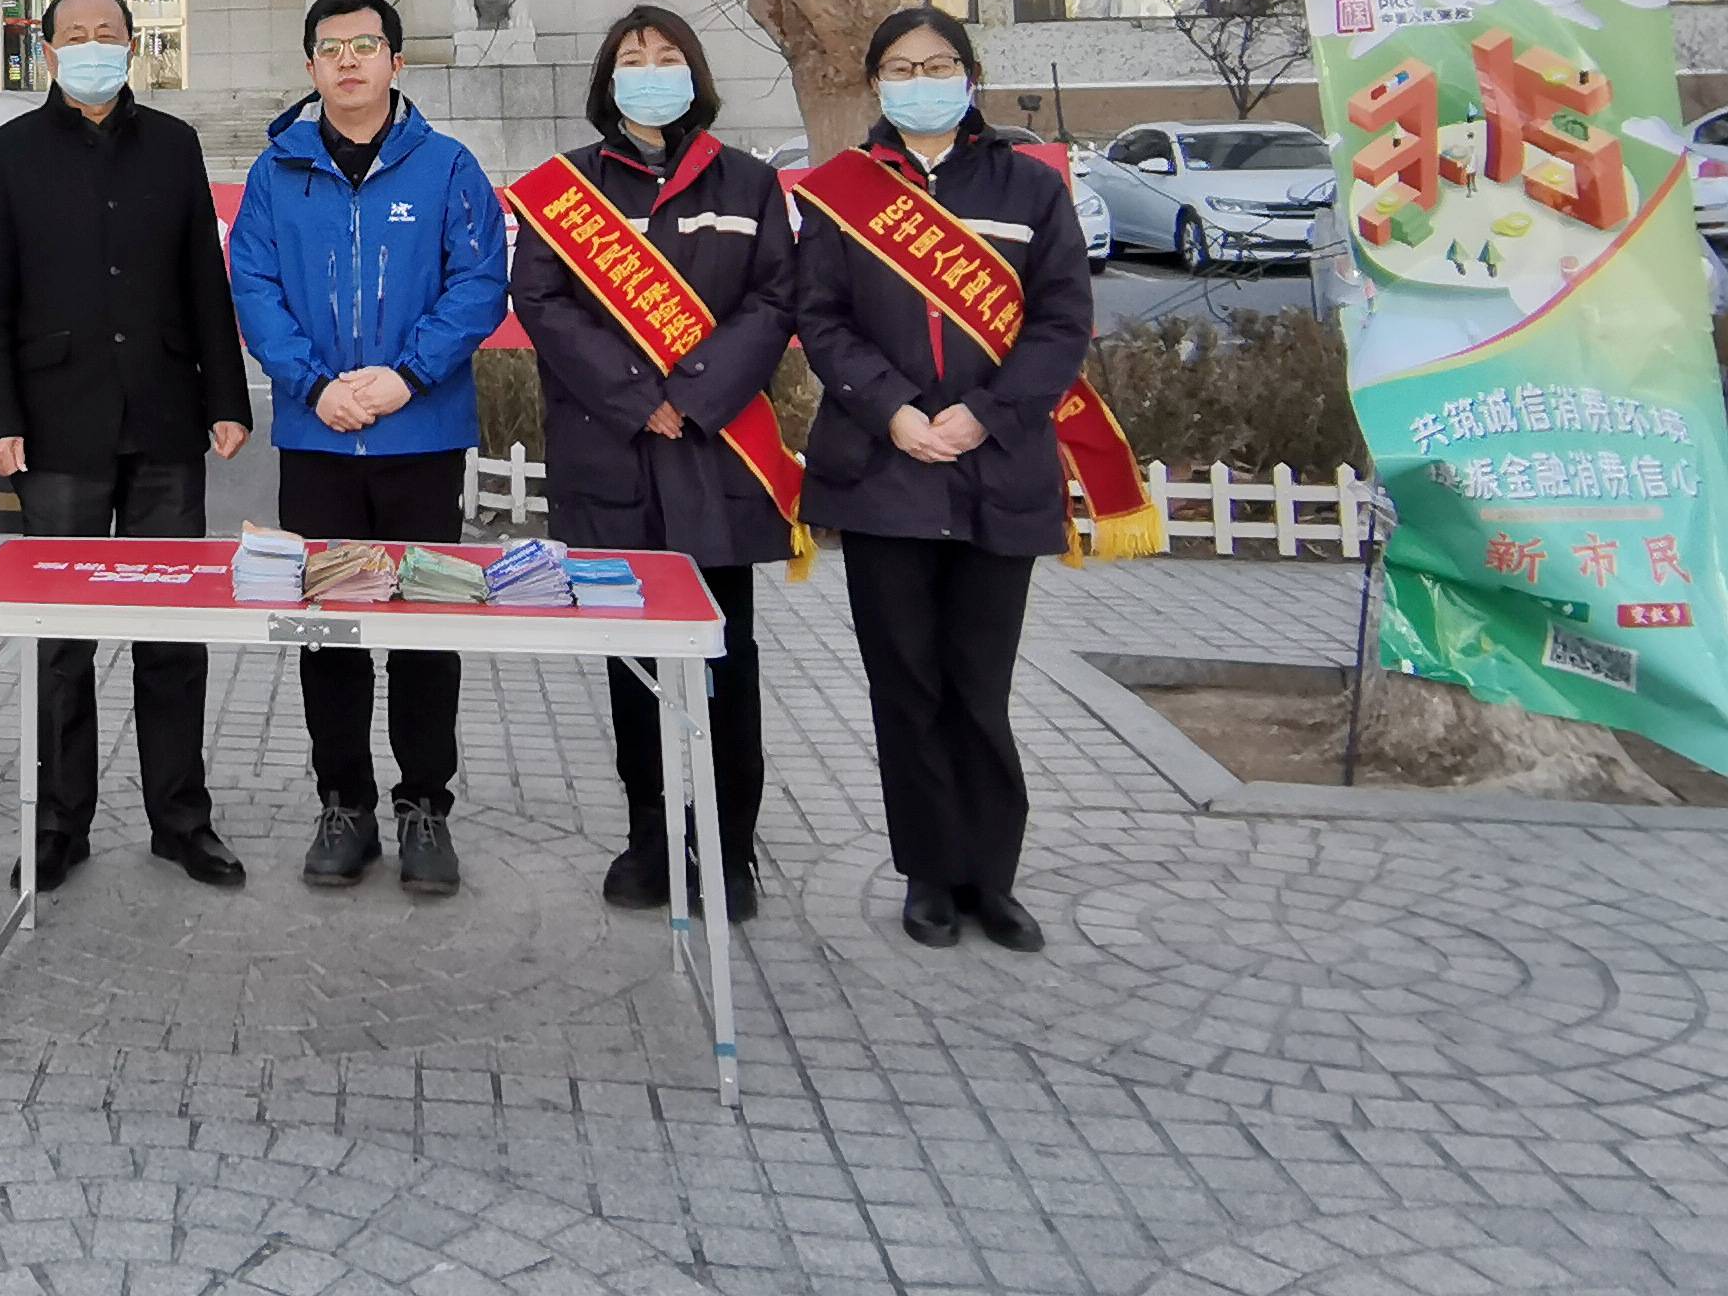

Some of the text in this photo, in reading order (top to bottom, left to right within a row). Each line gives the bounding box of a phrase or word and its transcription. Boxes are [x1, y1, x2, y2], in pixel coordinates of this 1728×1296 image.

[868, 195, 914, 235] PICC
[1409, 382, 1695, 455] 共筑诚信消费环境
[1485, 530, 1692, 588] 新市民
